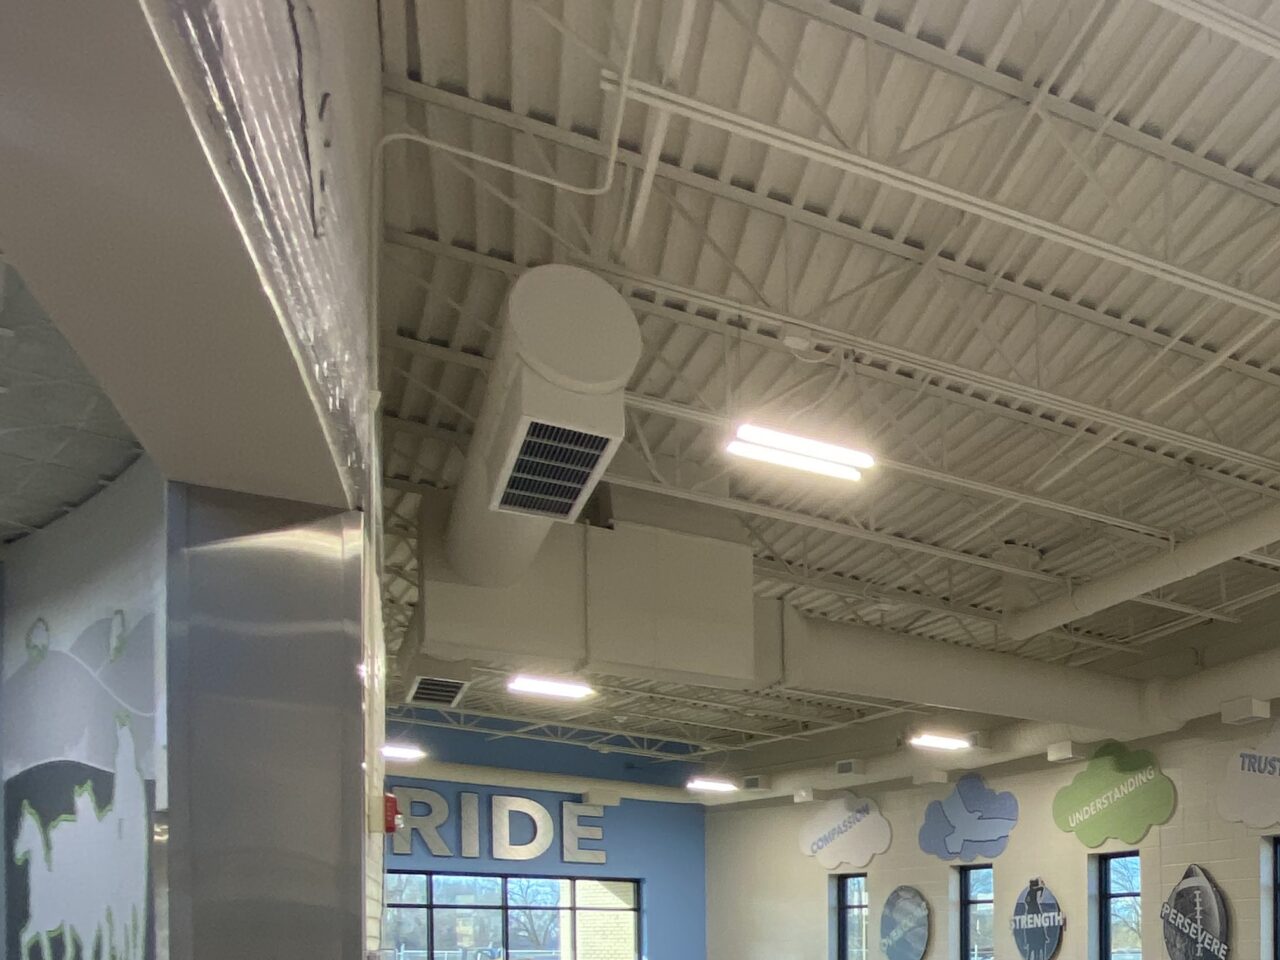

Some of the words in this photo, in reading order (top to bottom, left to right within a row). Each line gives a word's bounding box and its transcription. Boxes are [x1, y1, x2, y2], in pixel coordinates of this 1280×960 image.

[390, 785, 607, 865] RIDE
[1068, 765, 1155, 828] UNDERSTANDING
[810, 803, 870, 854] COMPASSION
[1010, 911, 1064, 930] STRENGTH
[1161, 902, 1229, 960] PERSEVERE
